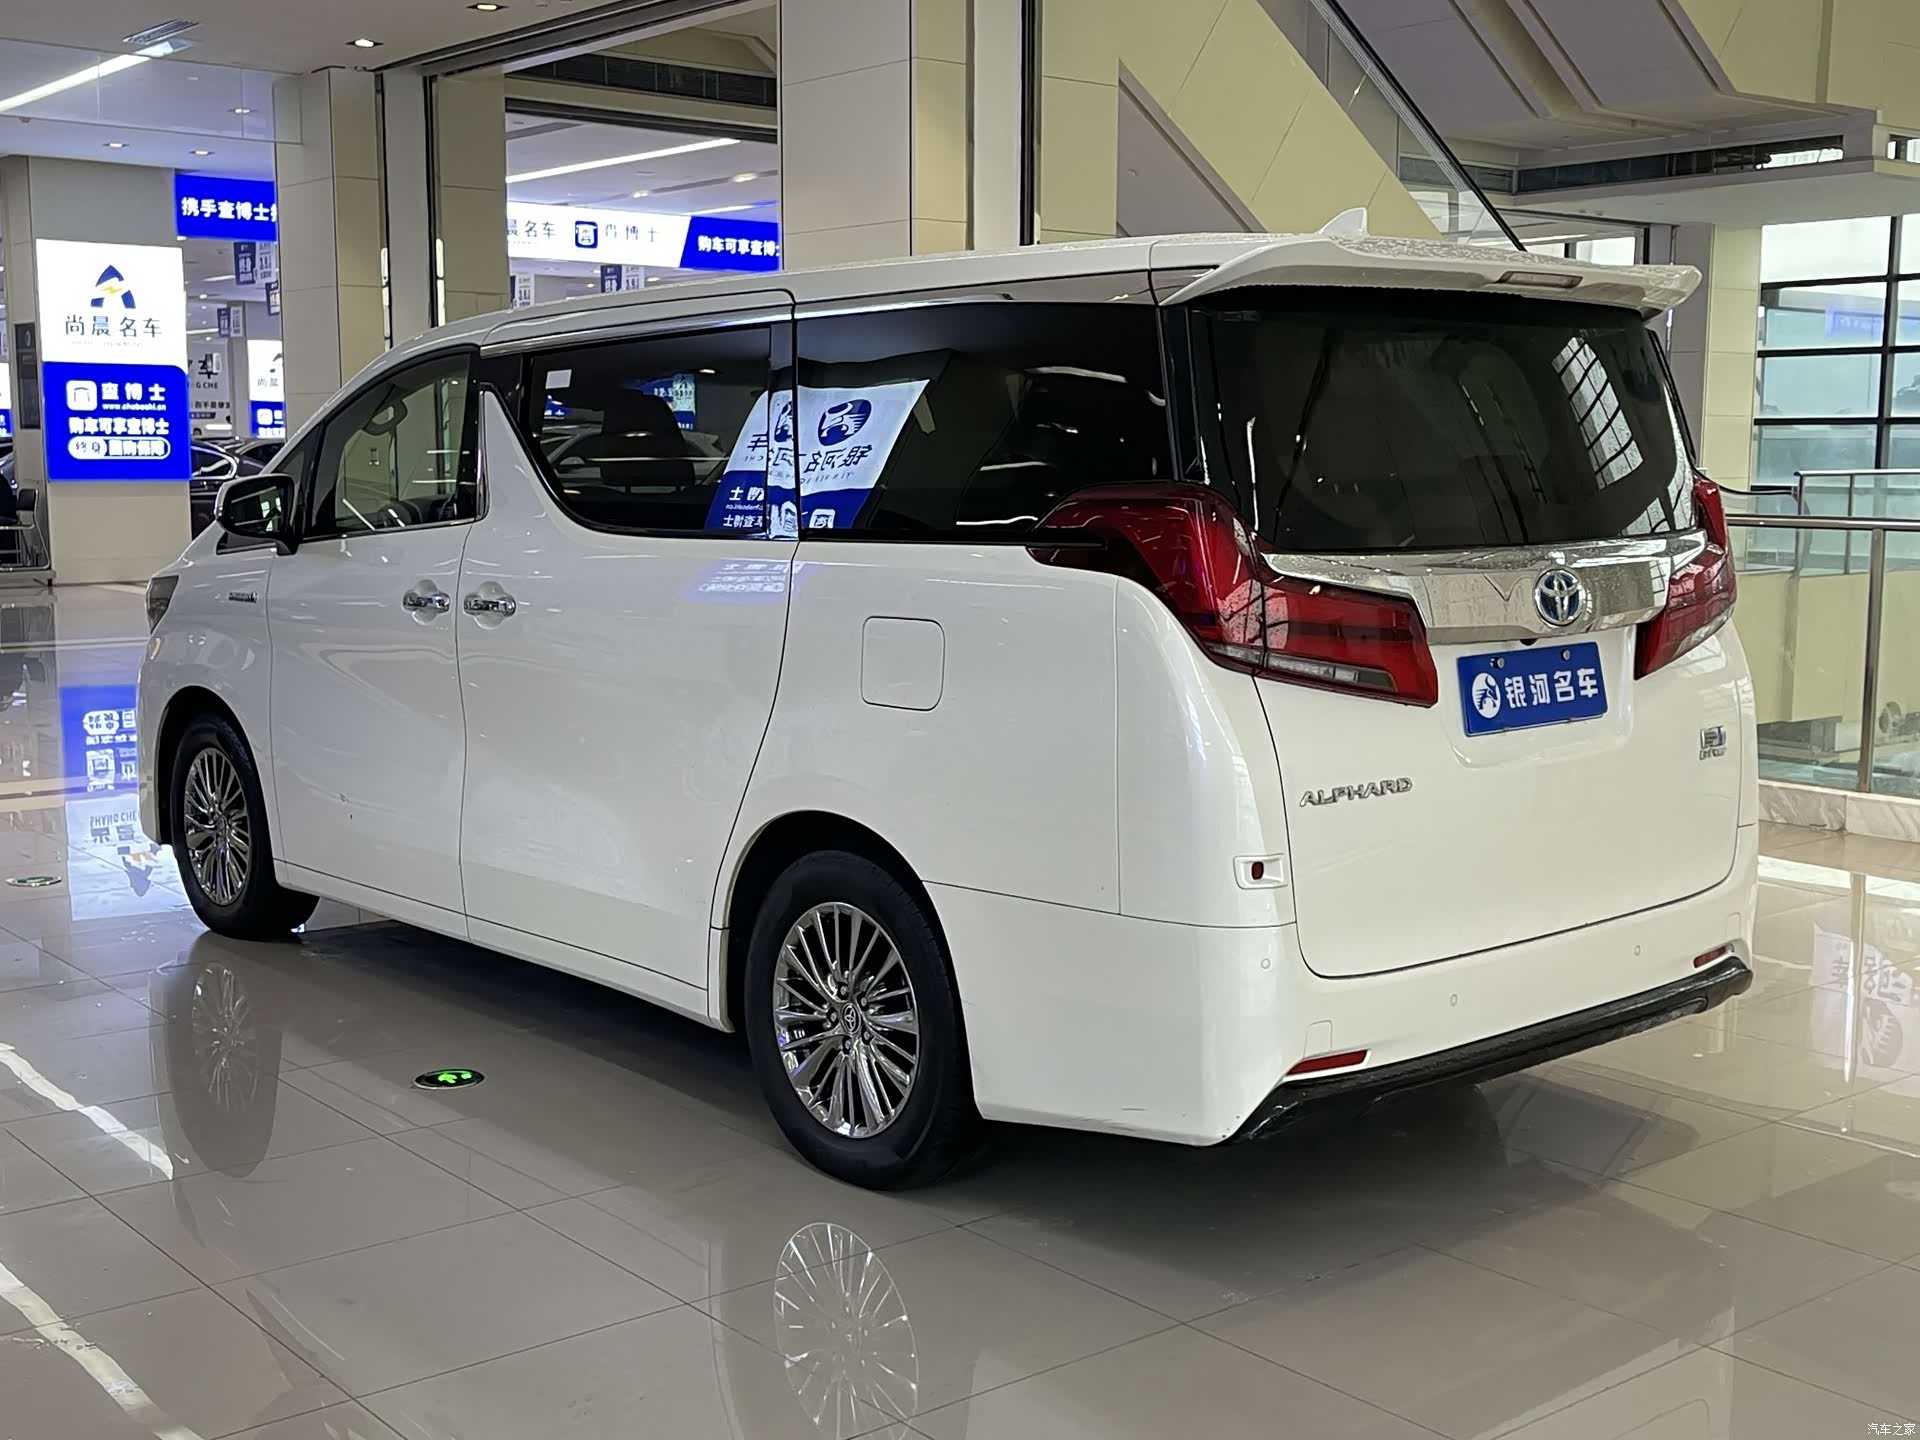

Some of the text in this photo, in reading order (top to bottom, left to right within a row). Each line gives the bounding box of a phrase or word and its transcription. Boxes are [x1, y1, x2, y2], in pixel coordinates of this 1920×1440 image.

[65, 314, 163, 338] 尚晨名车
[1504, 667, 1599, 709] 银河名车
[1299, 777, 1413, 808] ALPHARD
